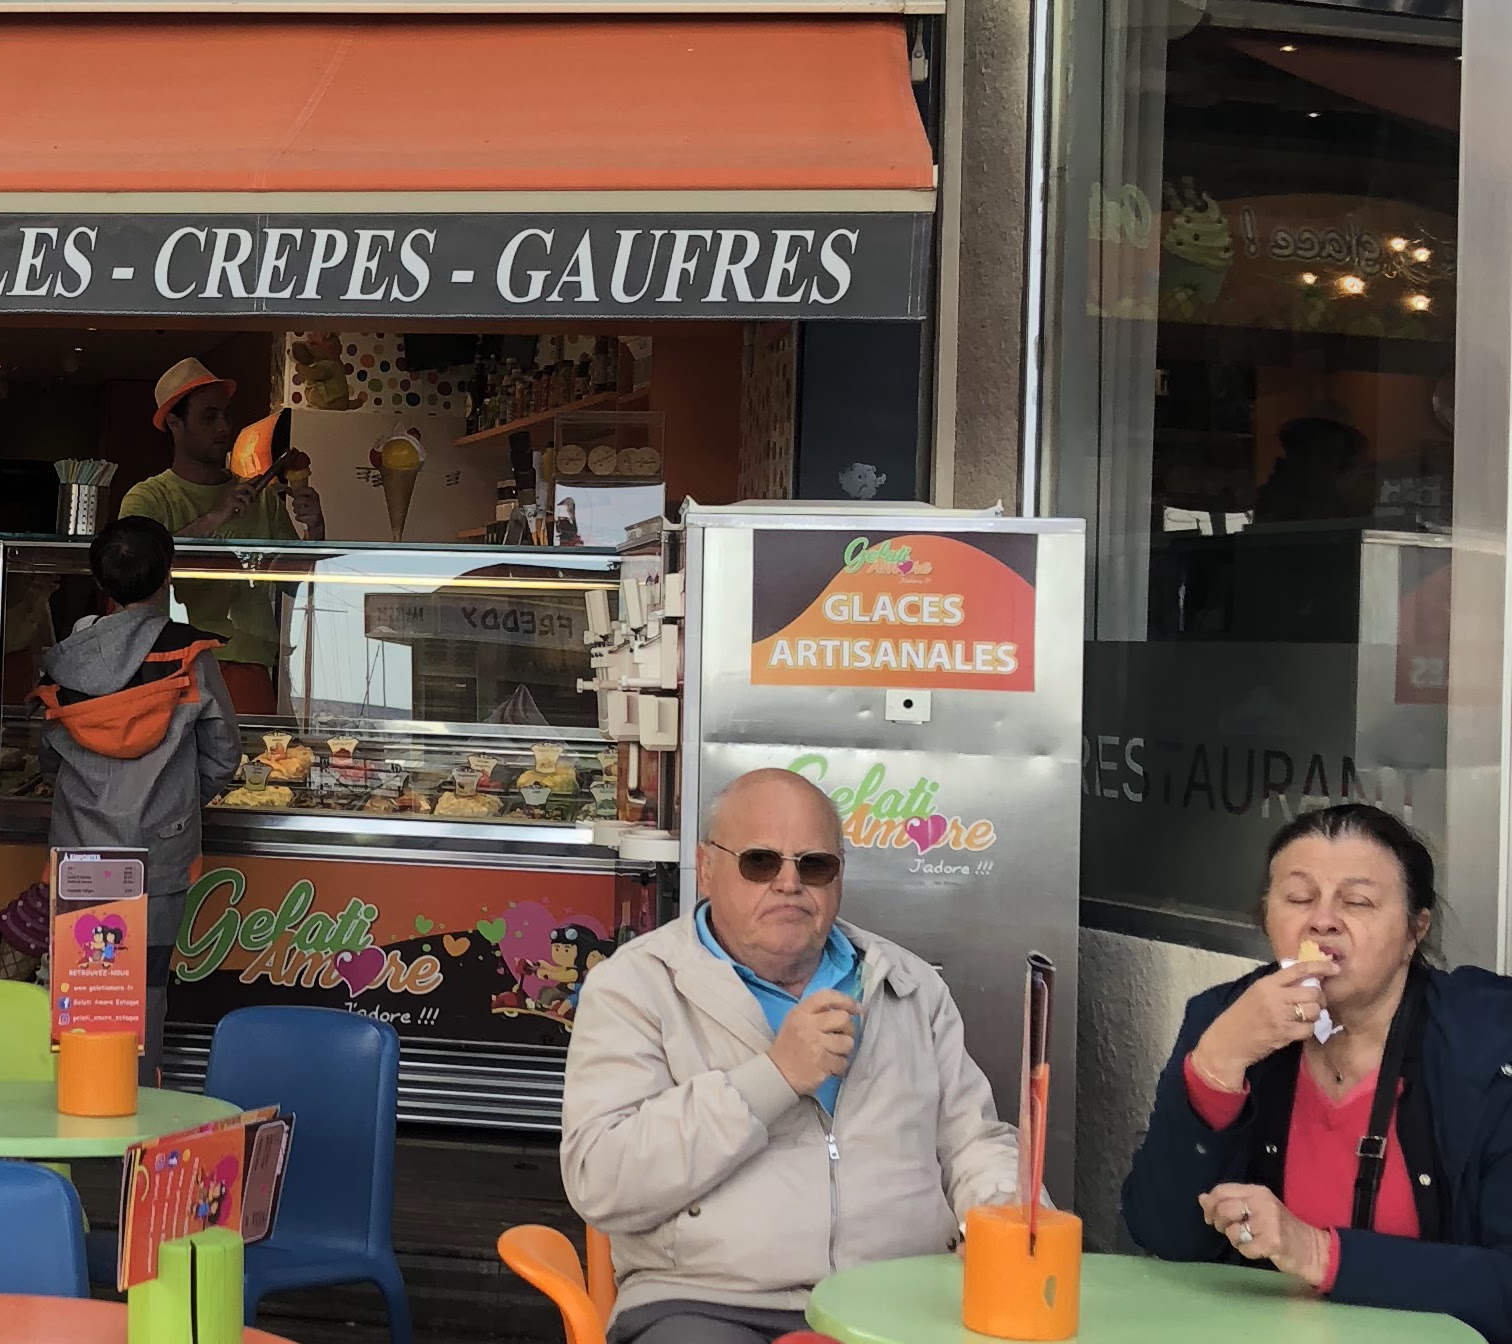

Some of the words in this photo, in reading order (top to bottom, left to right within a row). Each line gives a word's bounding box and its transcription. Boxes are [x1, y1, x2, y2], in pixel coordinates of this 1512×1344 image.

[153, 227, 436, 302] CREPES
[495, 227, 860, 304] GAUFRES
[824, 593, 963, 626] GLACES
[768, 638, 1018, 674] ARTISANALES
[175, 867, 379, 982] Gelati
